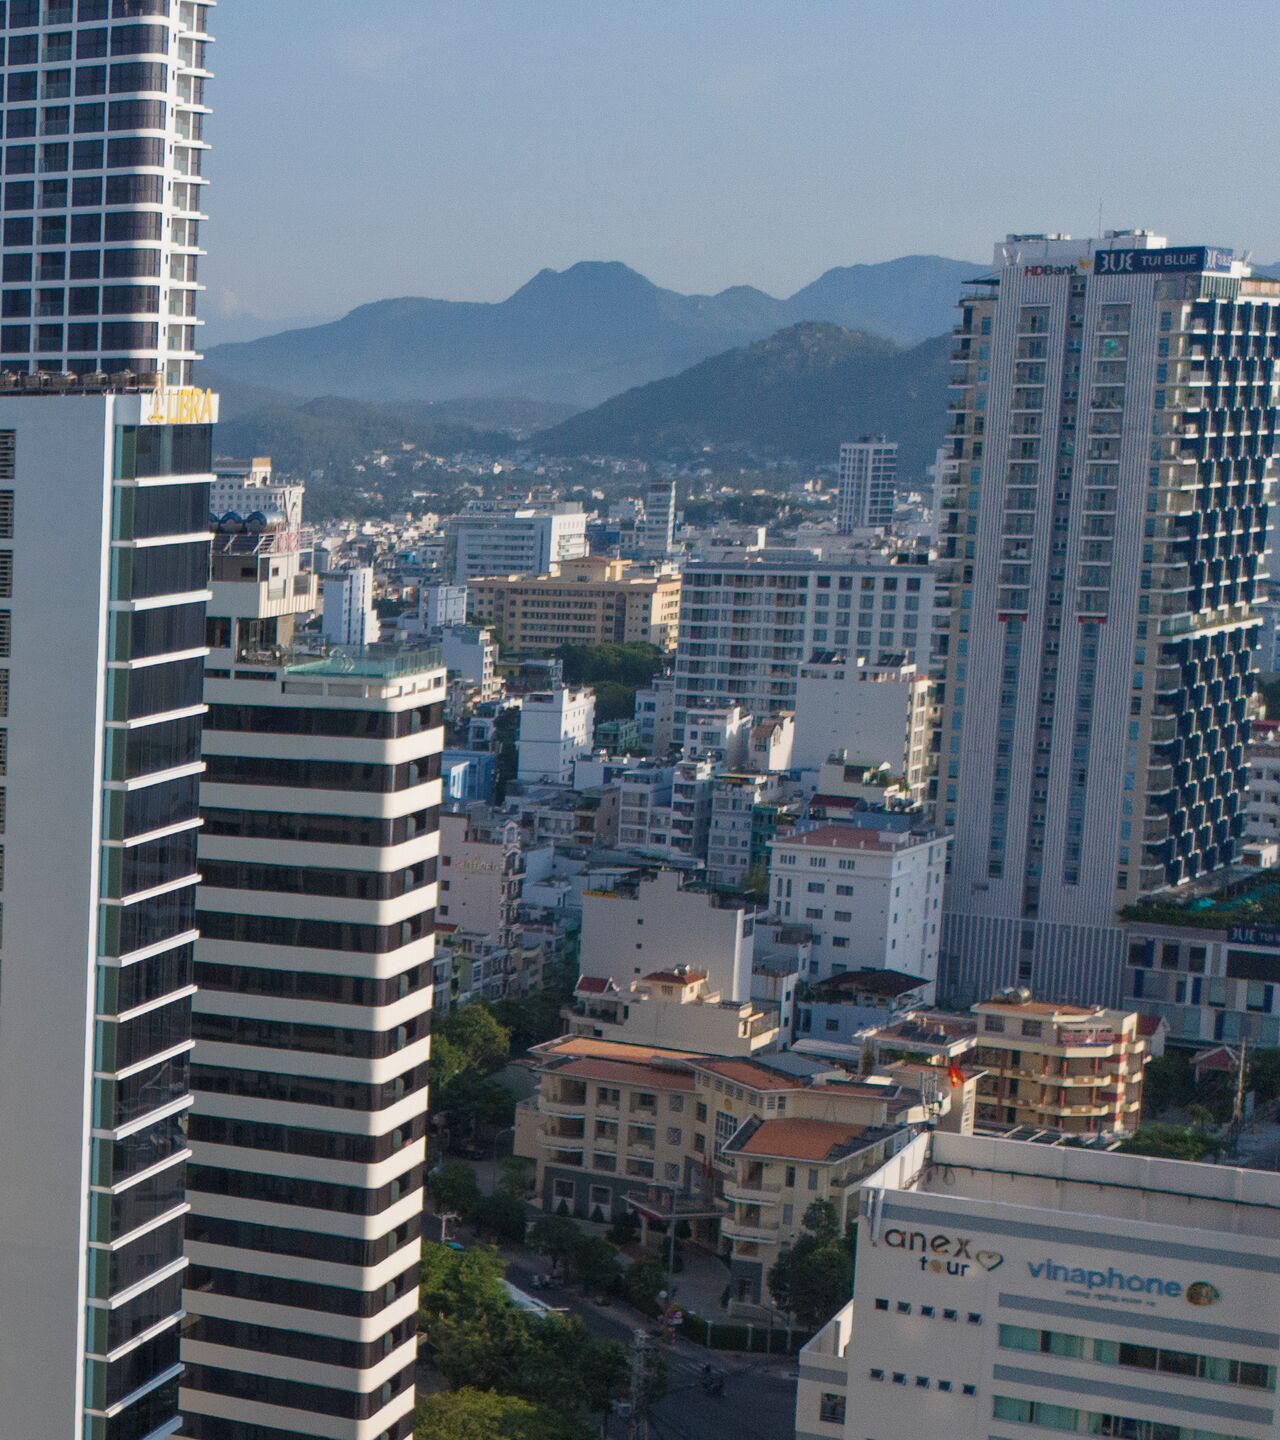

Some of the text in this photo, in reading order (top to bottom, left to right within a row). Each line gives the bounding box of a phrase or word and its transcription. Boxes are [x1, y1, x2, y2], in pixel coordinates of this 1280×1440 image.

[1024, 263, 1078, 277] HDBank
[1141, 256, 1161, 267] TUI
[1164, 253, 1197, 266] BLUE
[167, 387, 213, 424] LIBRA
[884, 1228, 972, 1260] anex
[1027, 1258, 1182, 1297] vinaphone
